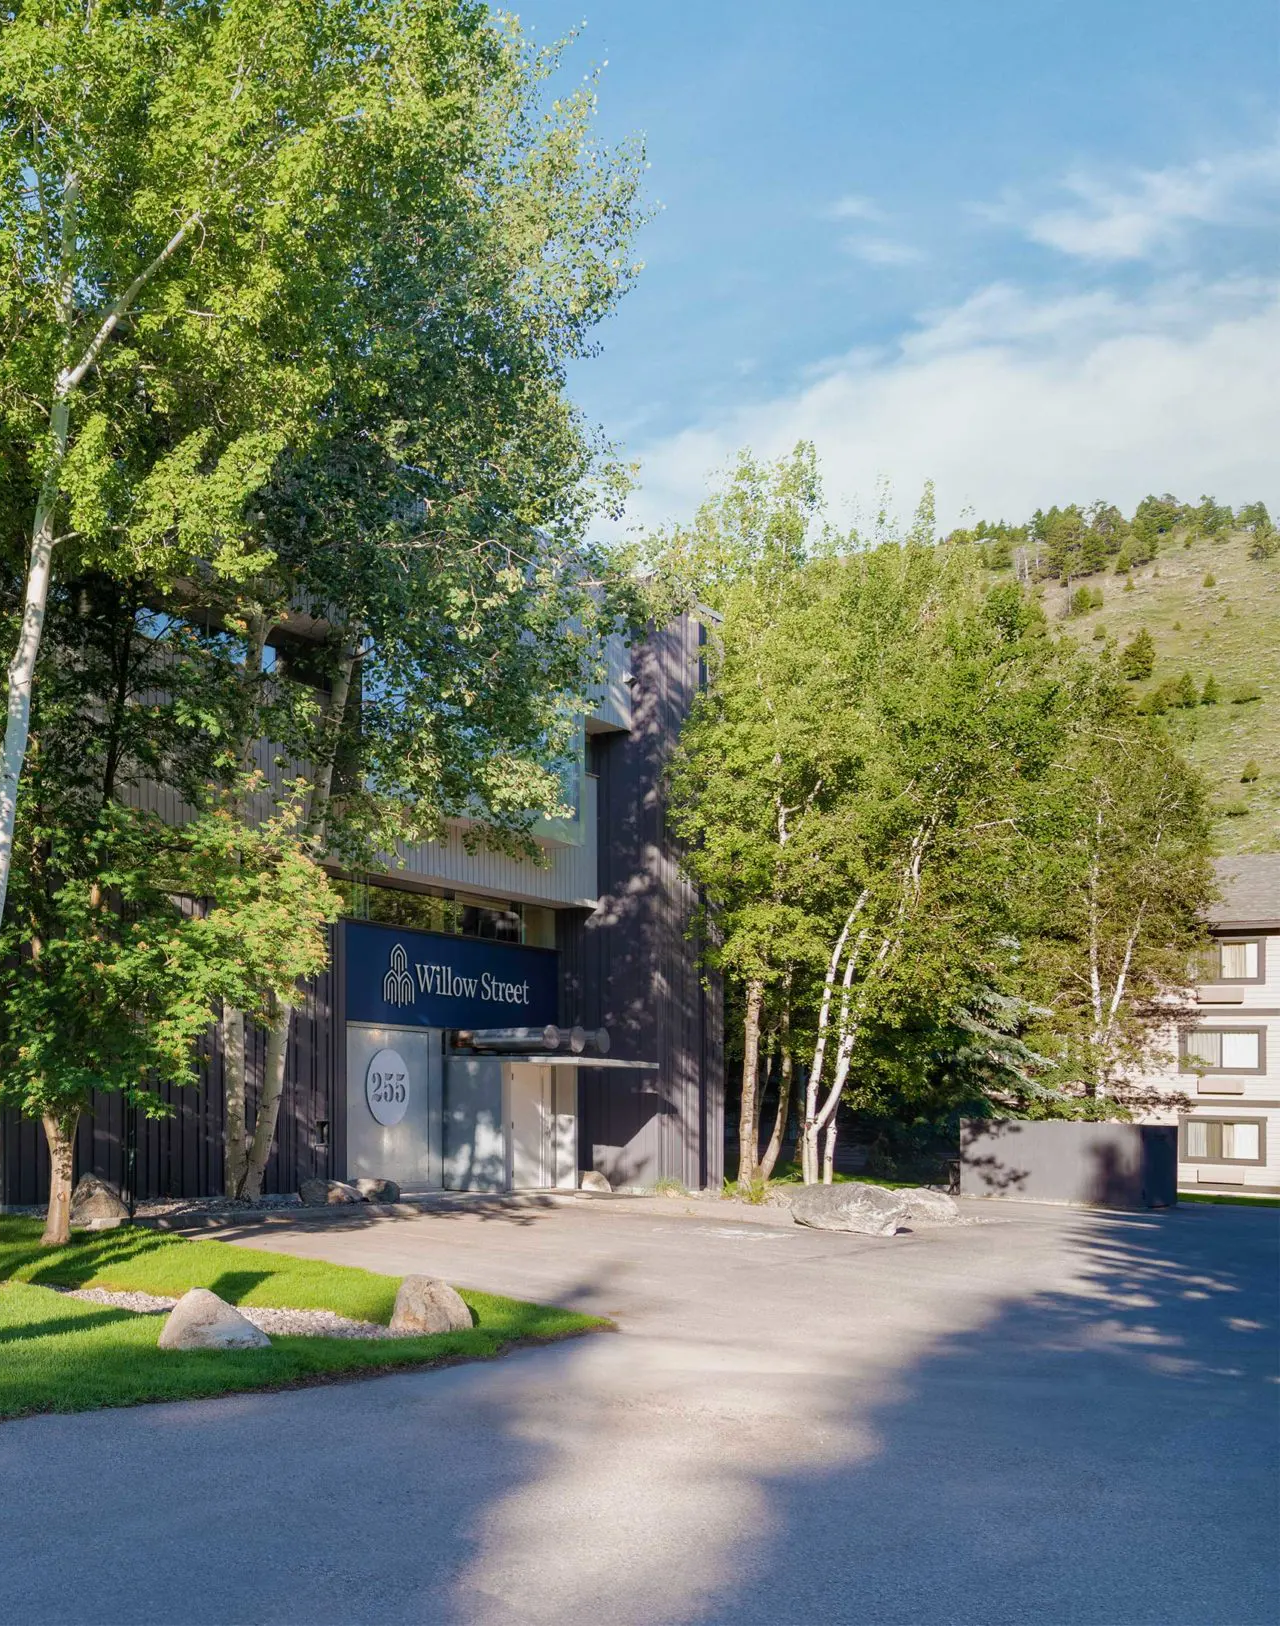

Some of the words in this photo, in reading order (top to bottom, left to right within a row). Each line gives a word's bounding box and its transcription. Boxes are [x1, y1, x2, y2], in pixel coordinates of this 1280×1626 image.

[414, 963, 478, 998] Willow
[481, 972, 530, 1005] Street
[371, 1072, 406, 1103] 255
